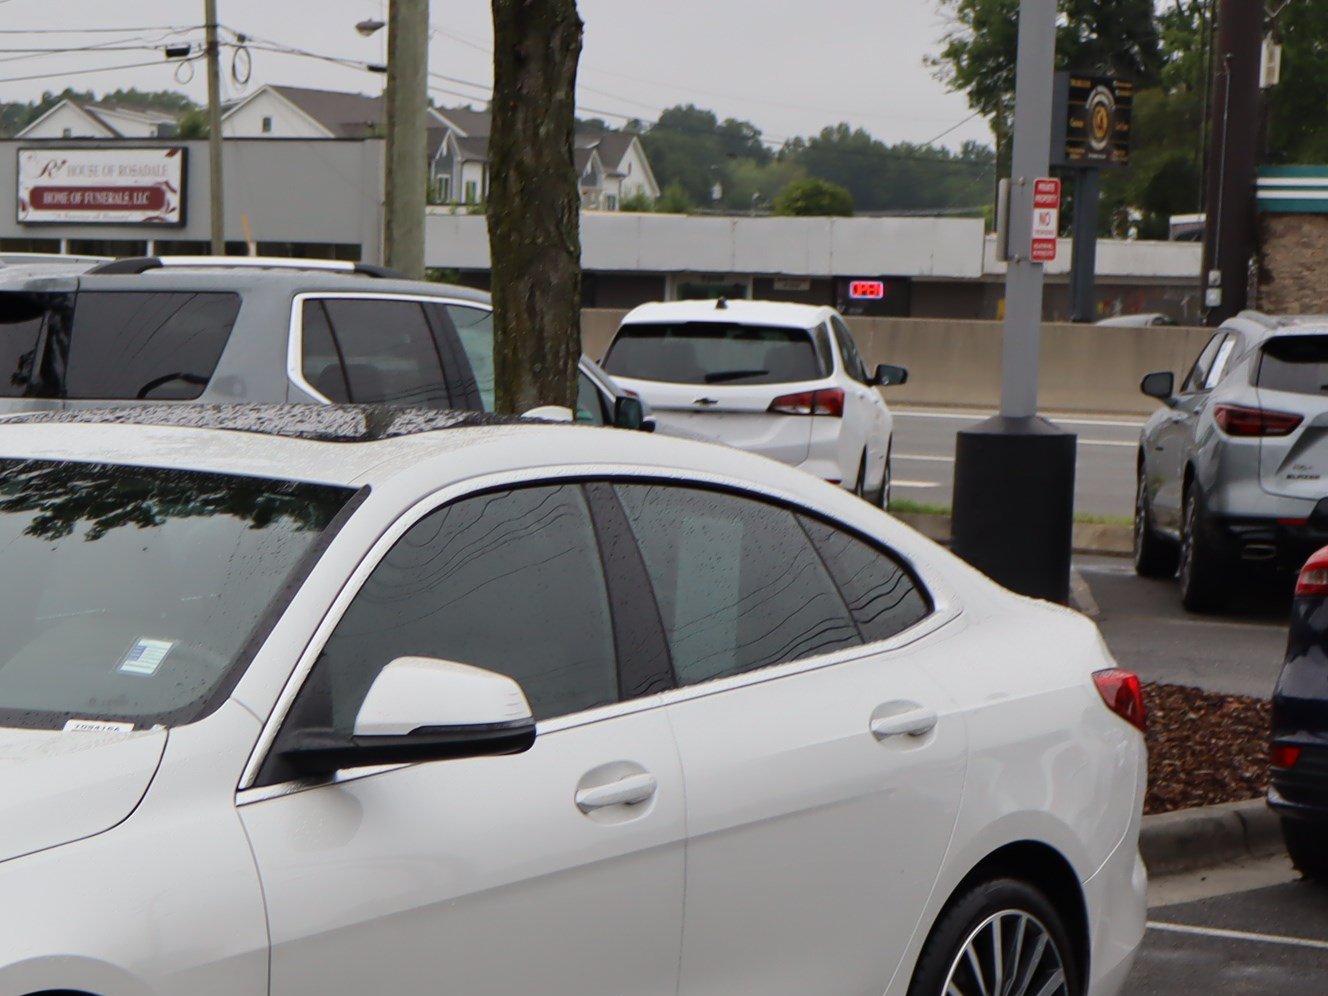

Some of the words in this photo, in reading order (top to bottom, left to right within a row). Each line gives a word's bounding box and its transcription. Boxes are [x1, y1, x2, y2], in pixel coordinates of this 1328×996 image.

[67, 165, 97, 178] HOUSE
[102, 165, 114, 178] OF
[42, 191, 68, 204] HOME
[70, 191, 82, 204] OF
[1039, 212, 1051, 226] NO
